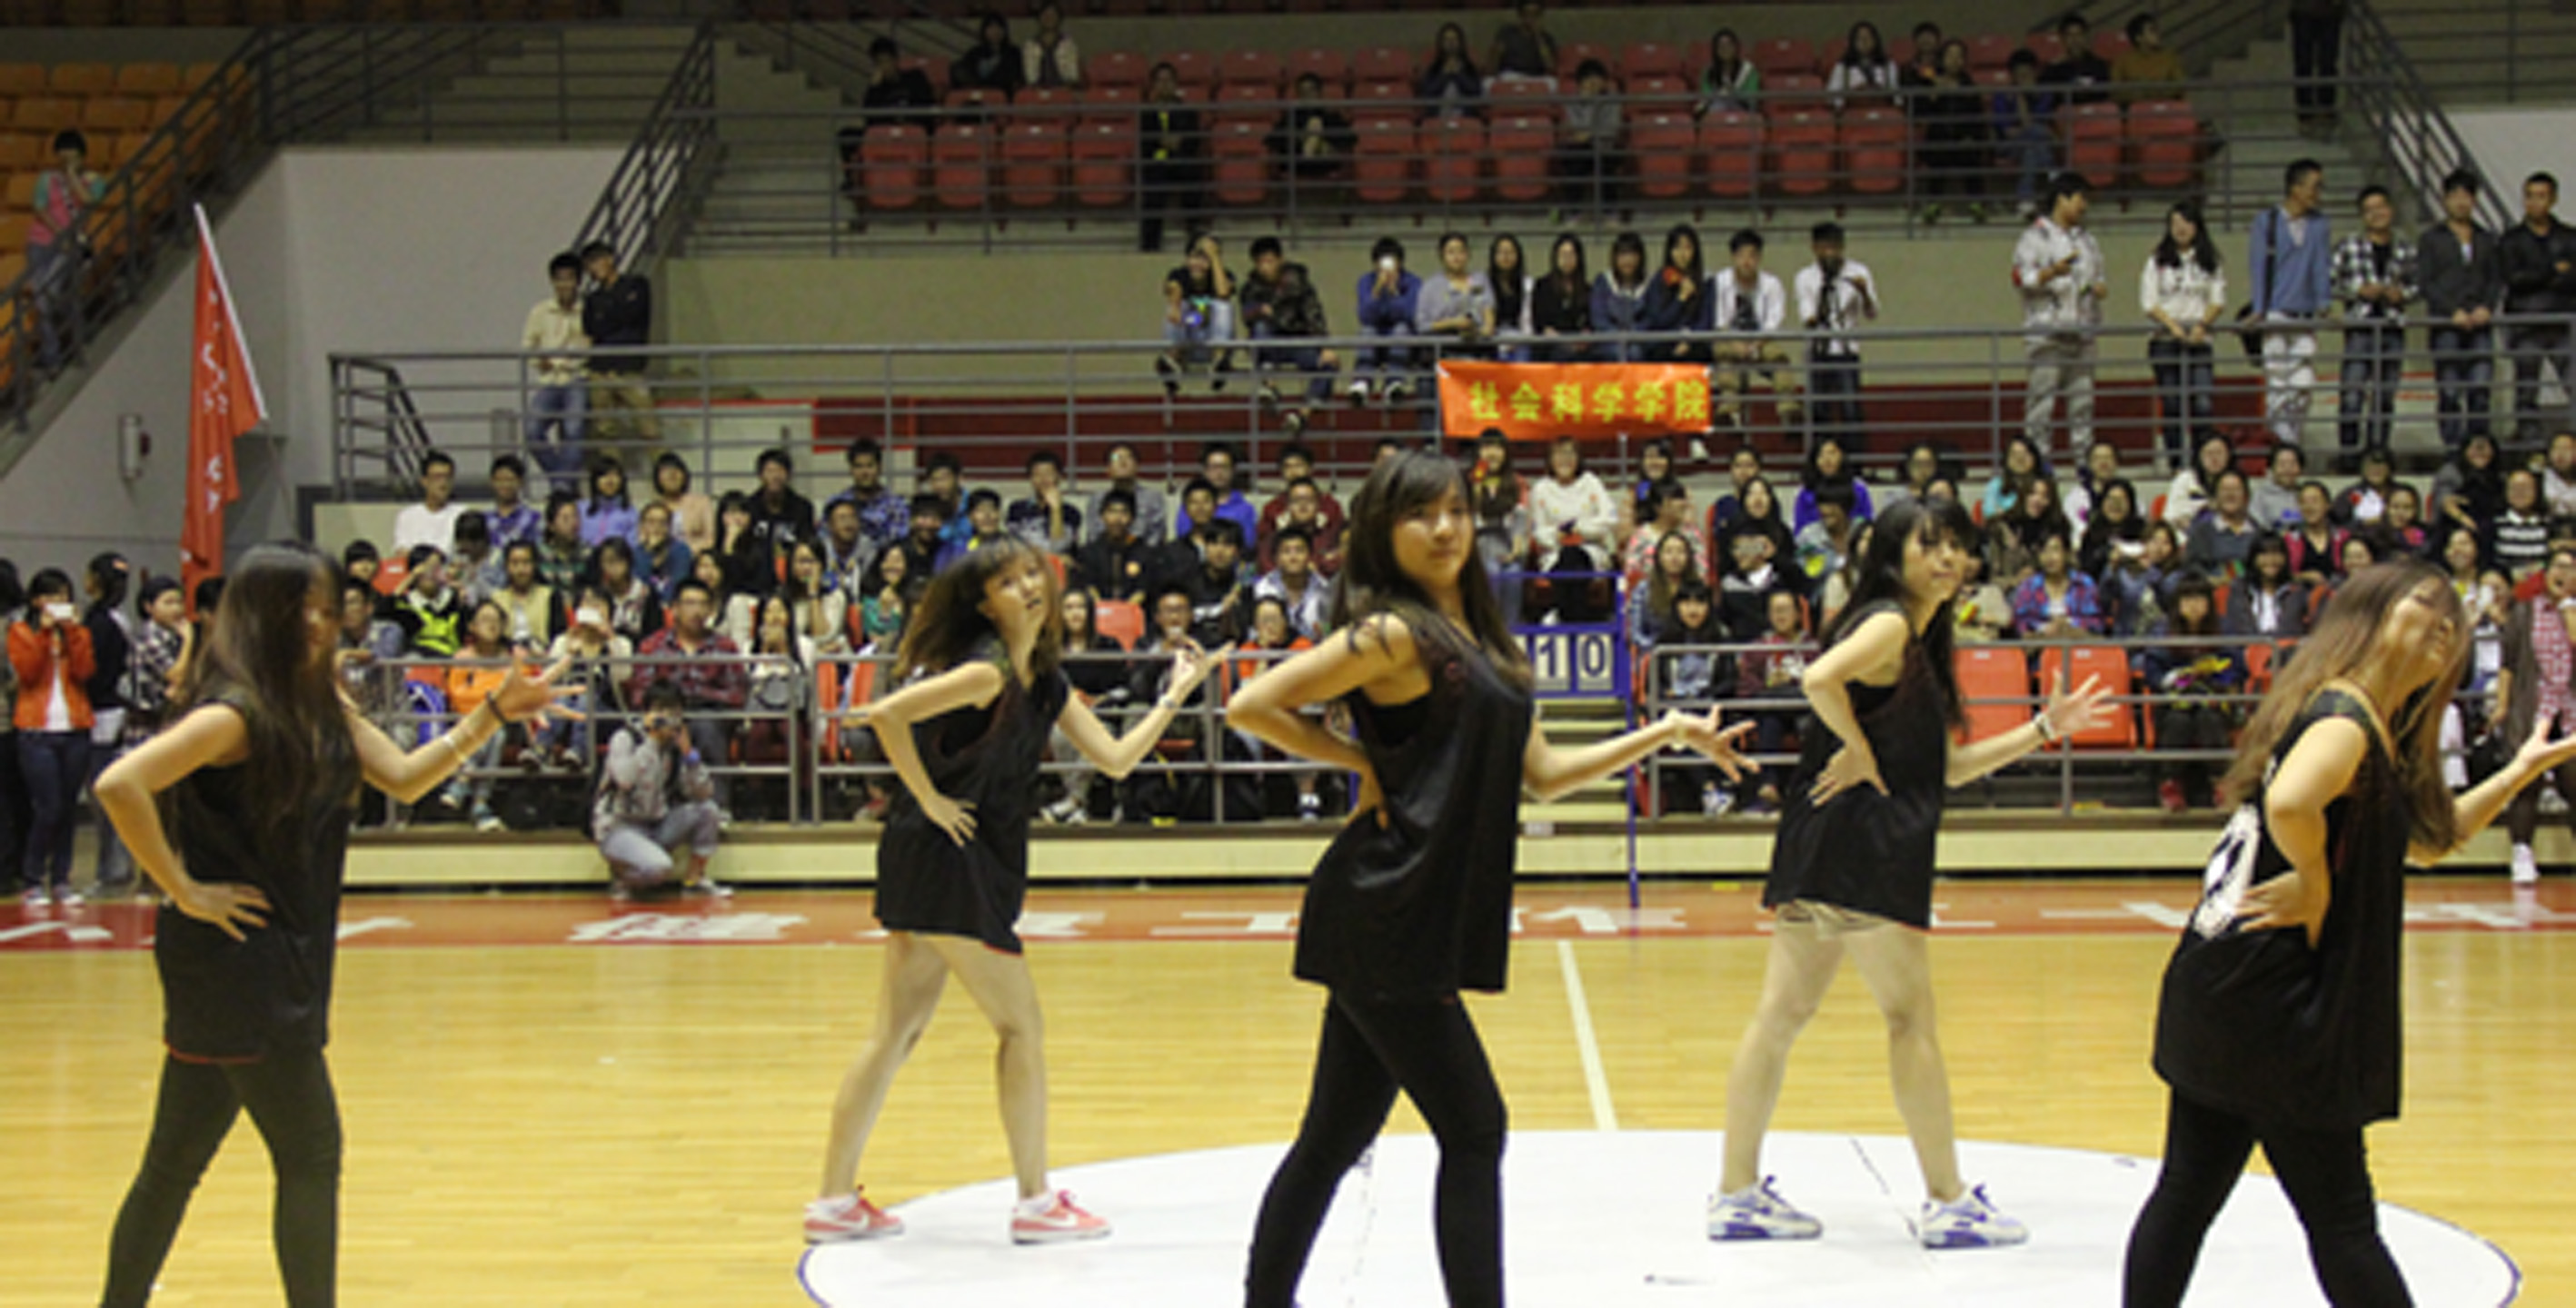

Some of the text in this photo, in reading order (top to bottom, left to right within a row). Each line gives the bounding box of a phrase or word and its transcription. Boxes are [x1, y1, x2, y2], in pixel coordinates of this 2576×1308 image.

[1469, 380, 1708, 423] 社会科学学院
